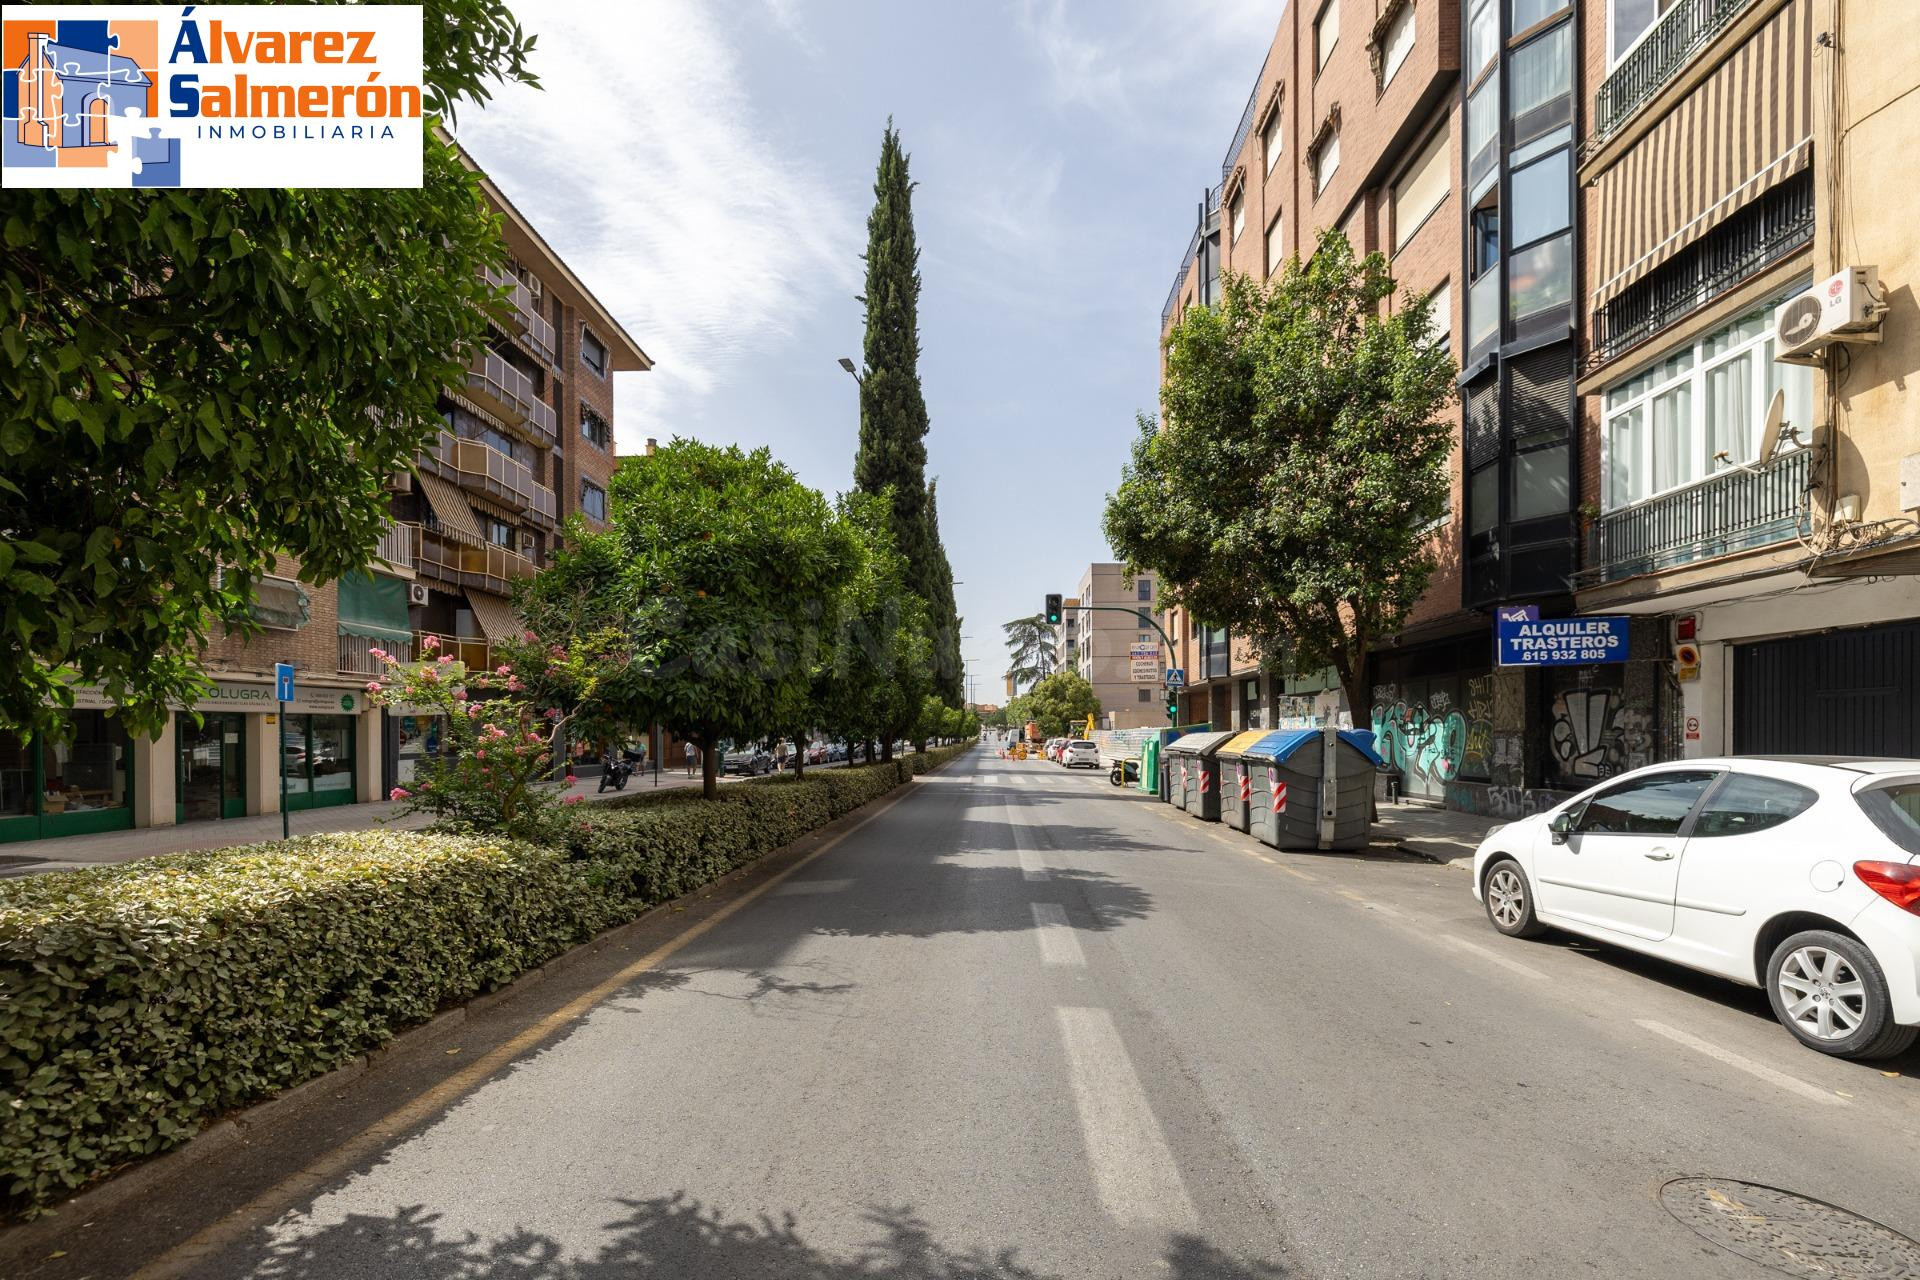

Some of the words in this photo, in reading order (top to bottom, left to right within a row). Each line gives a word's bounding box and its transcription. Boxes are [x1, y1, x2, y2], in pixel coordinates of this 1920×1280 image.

[1829, 296, 1842, 307] LG
[1519, 622, 1610, 637] ALQUILER
[1510, 635, 1619, 650] TRASTEROS
[1523, 651, 1548, 660] 615
[1551, 650, 1577, 660] 932
[1581, 649, 1606, 659] 805
